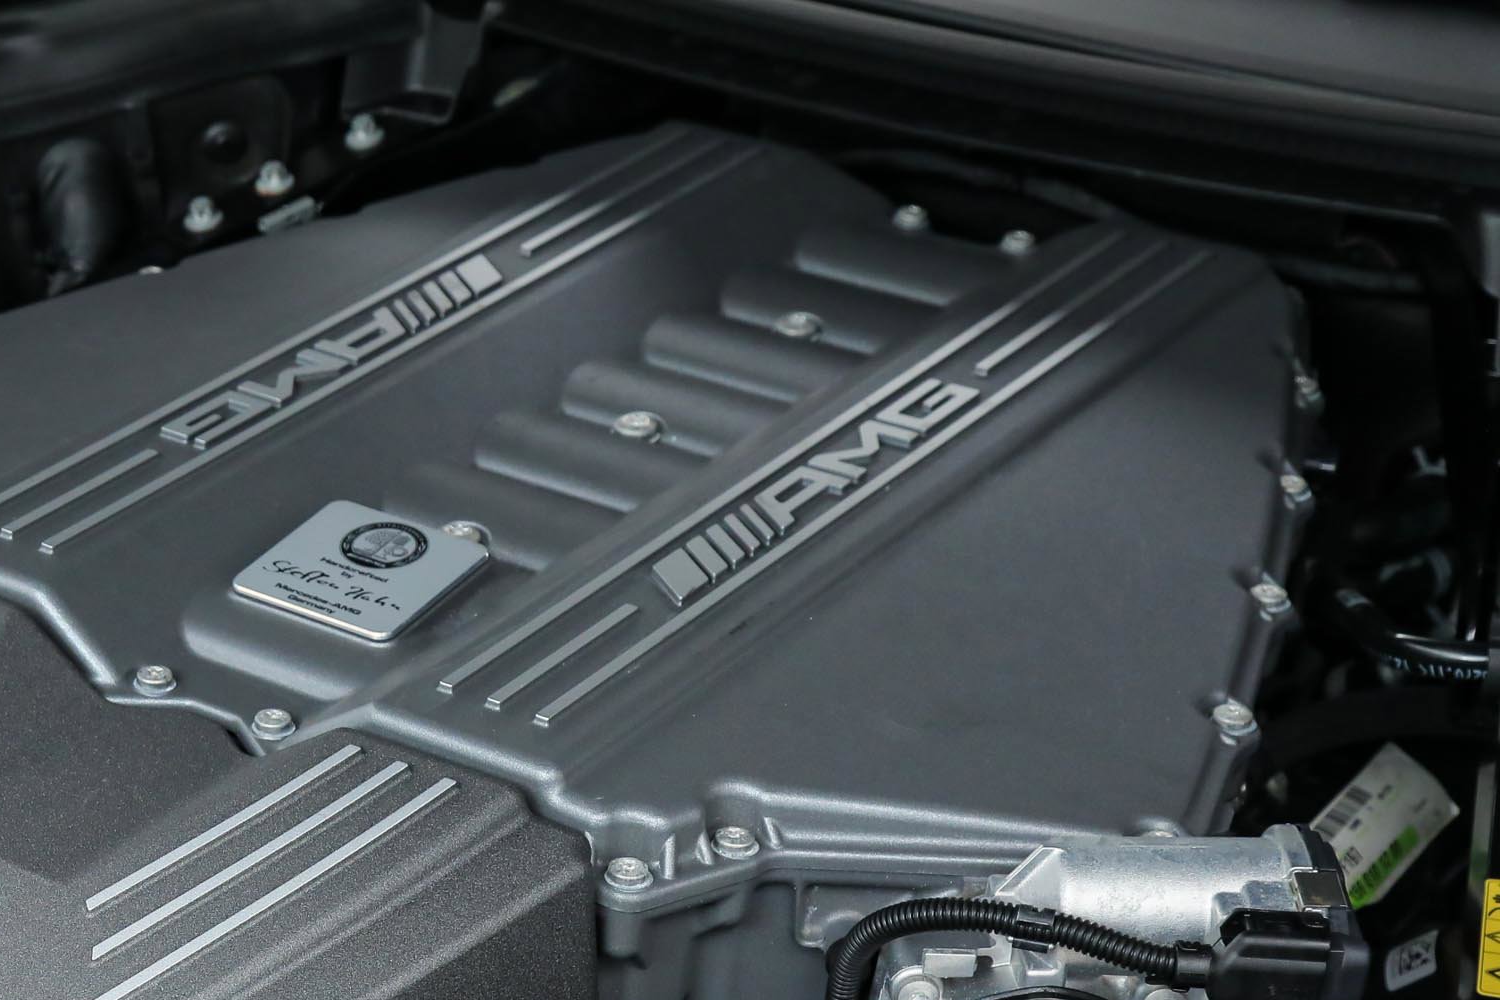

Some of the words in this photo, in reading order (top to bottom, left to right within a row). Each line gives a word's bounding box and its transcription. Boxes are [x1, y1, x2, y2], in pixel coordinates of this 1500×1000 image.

[160, 306, 406, 448] AMG
[754, 378, 981, 535] AMG
[320, 557, 389, 583] Handcrafted
[275, 582, 362, 615] Mercedes-AMG
[287, 594, 336, 614] Germany
